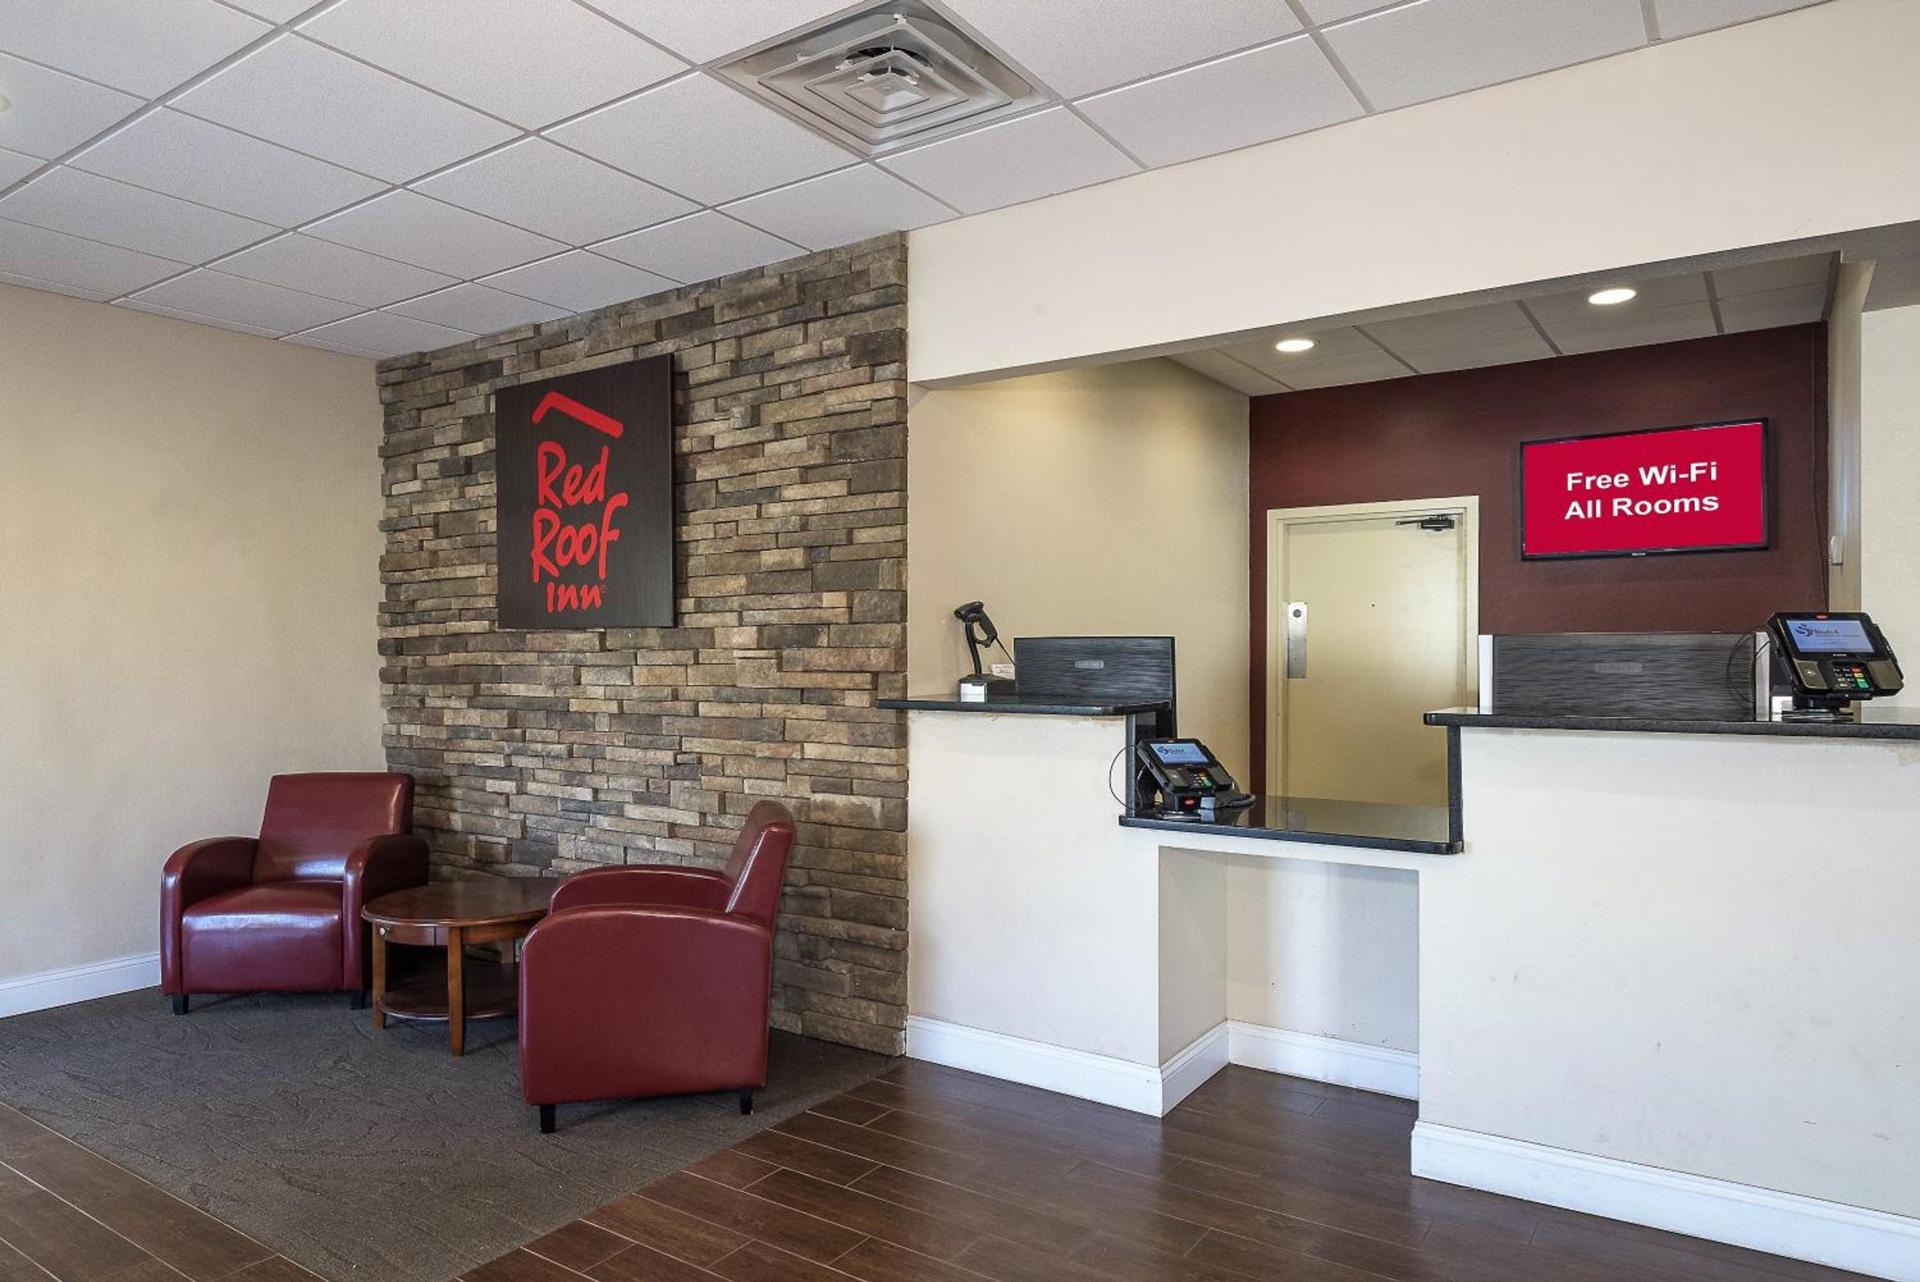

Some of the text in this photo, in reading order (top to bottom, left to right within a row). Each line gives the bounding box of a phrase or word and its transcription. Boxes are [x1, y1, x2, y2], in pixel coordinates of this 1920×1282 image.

[537, 441, 610, 509] Red
[1566, 461, 1718, 492] Free Wi-Fi
[1564, 495, 1720, 520] All Rooms
[531, 492, 629, 583] Roof
